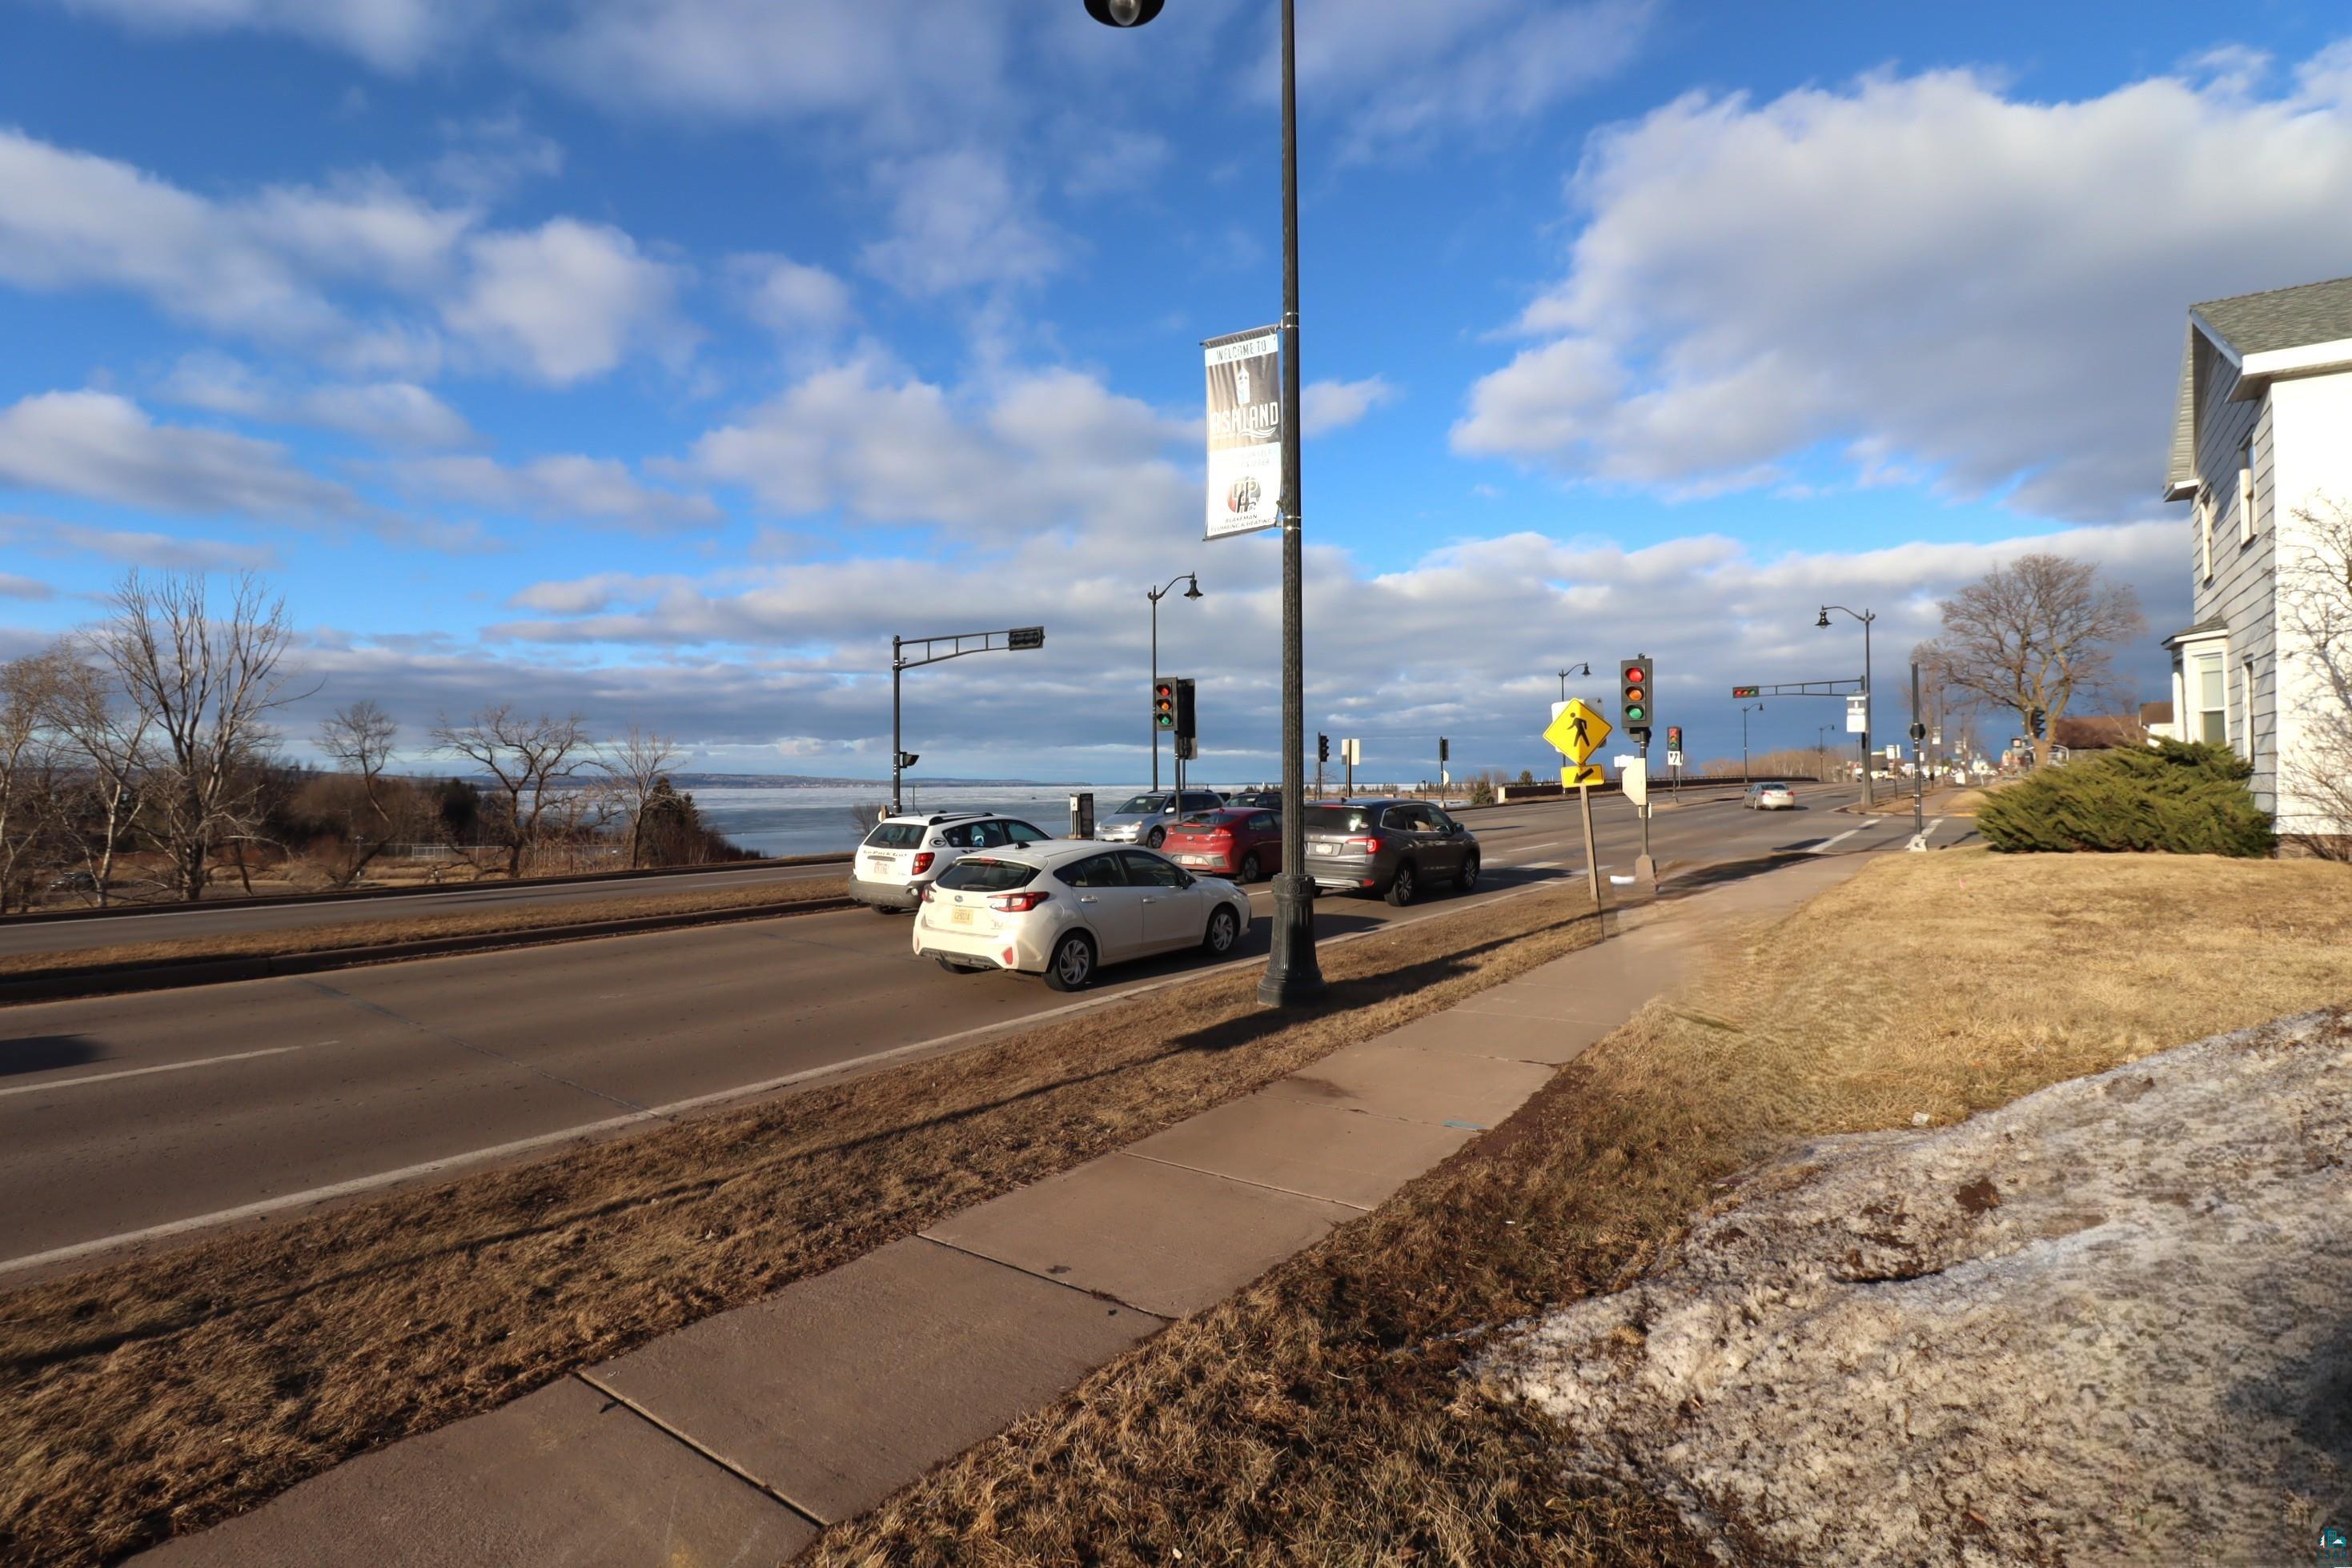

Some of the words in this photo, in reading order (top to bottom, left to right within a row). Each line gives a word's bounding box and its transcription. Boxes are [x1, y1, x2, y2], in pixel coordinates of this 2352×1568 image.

[1216, 343, 1254, 361] WELCOME
[1257, 339, 1266, 353] TO
[1210, 402, 1279, 434] ASHLAND
[1225, 514, 1258, 524] BLAKEMAN
[1246, 518, 1272, 527] HEATING
